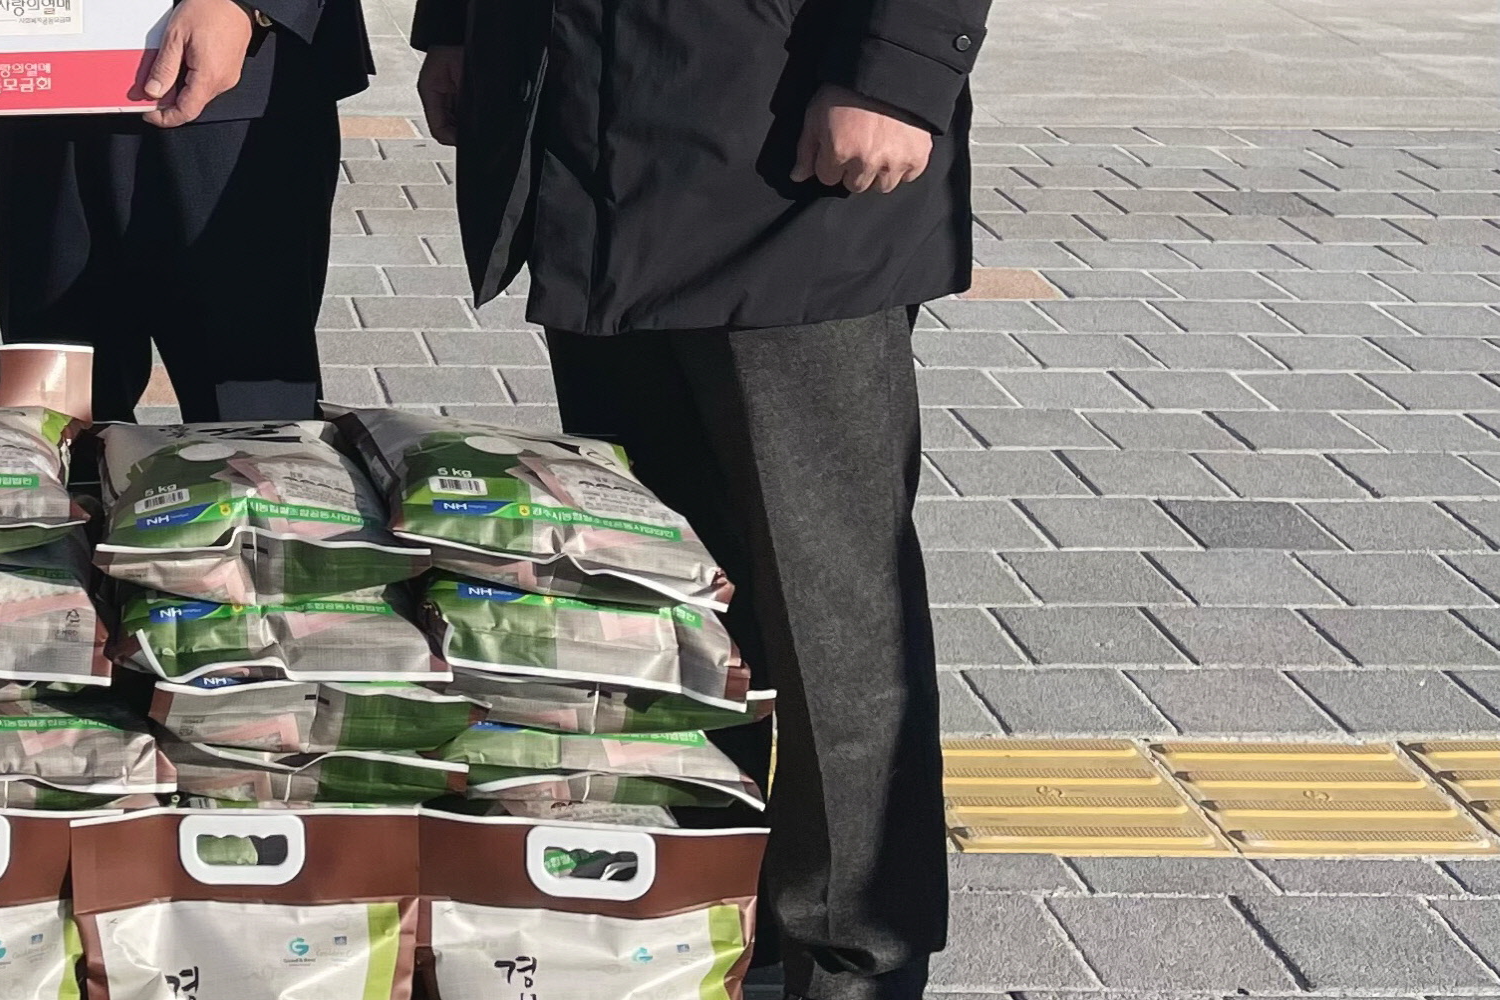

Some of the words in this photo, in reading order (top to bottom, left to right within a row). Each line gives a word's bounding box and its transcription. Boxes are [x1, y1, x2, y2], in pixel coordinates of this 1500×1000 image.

[451, 467, 472, 478] kg
[146, 515, 170, 526] NH
[468, 587, 493, 597] NH
[159, 607, 183, 618] NH
[203, 677, 228, 686] NH
